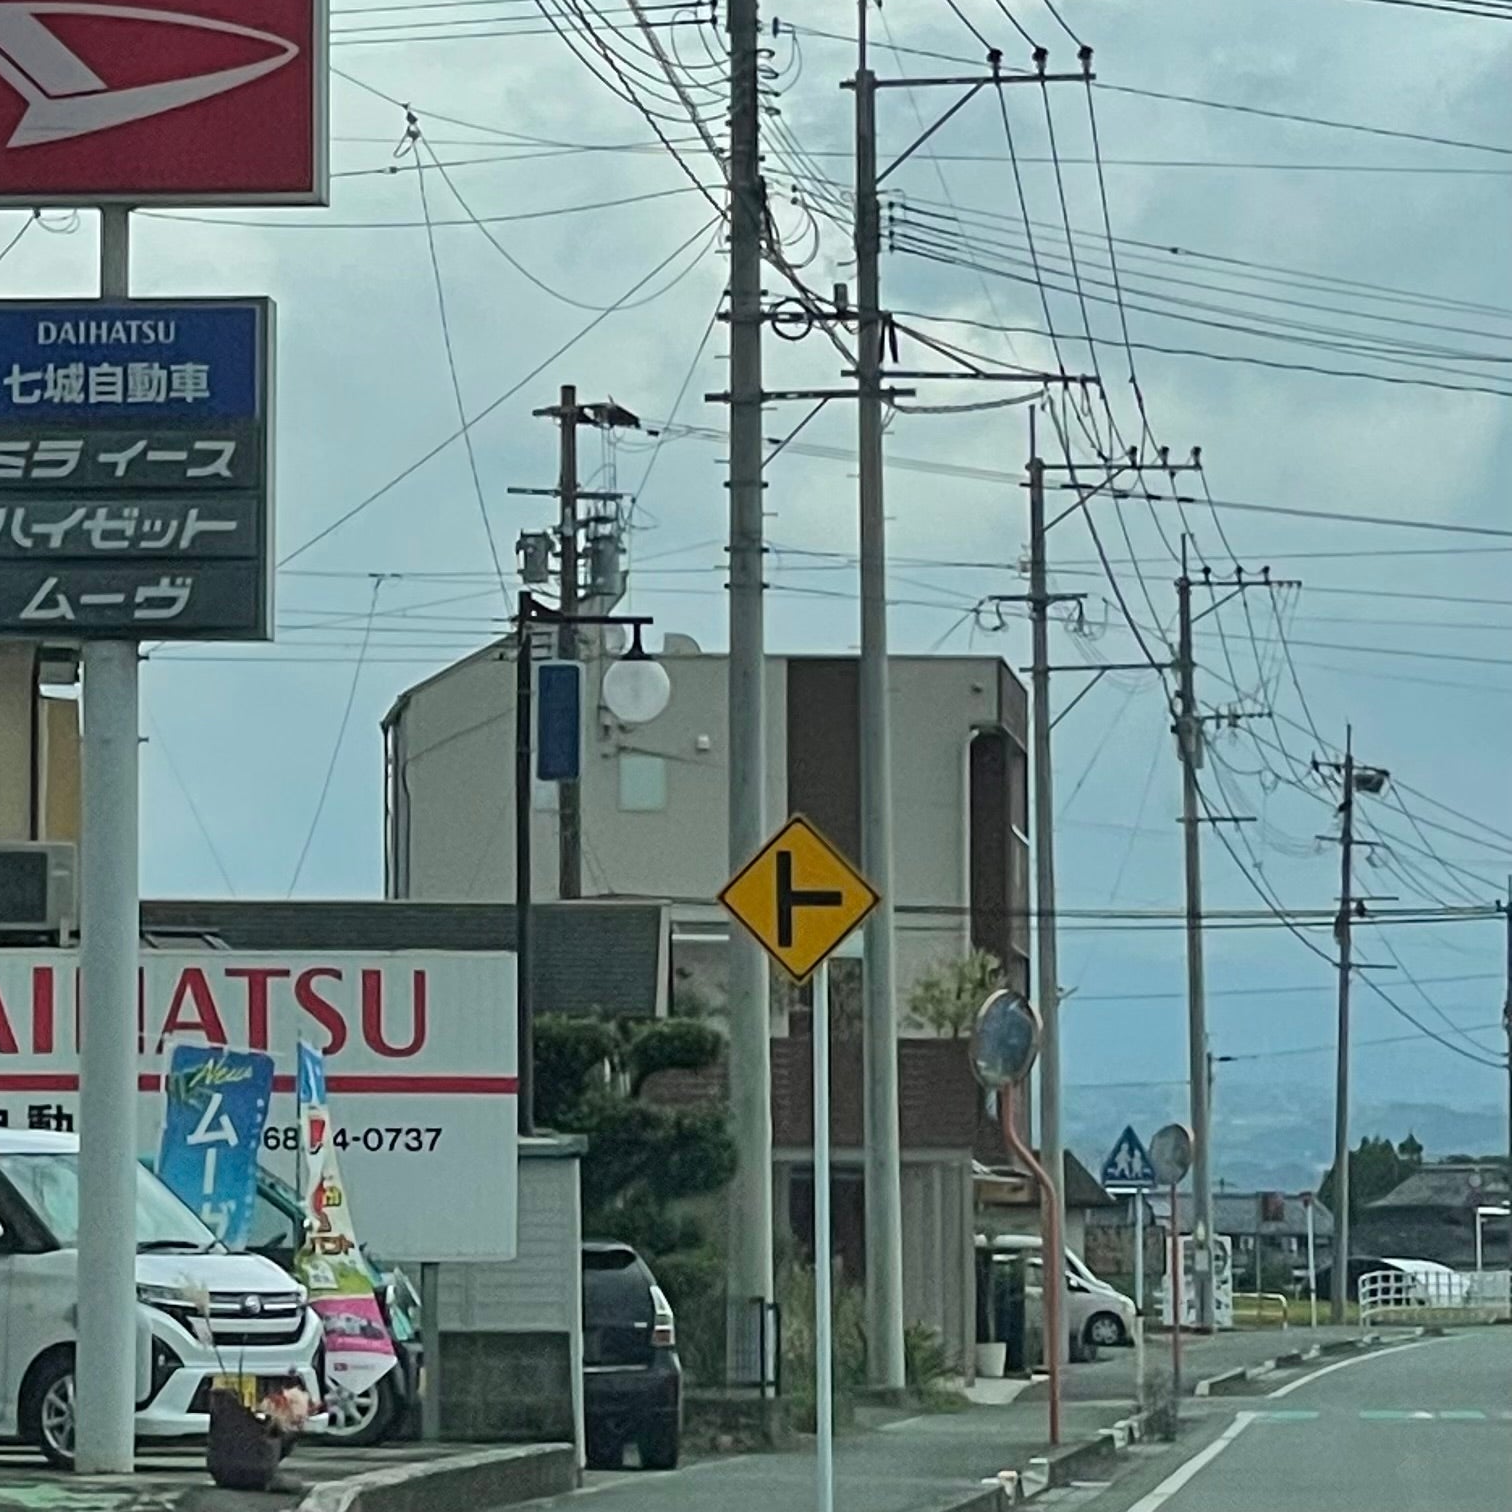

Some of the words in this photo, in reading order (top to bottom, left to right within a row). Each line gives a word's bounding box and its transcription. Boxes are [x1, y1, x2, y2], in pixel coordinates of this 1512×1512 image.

[37, 320, 177, 345] DAIHATSU
[3, 362, 211, 404] 七城自動車
[19, 576, 193, 621] ムーヴ
